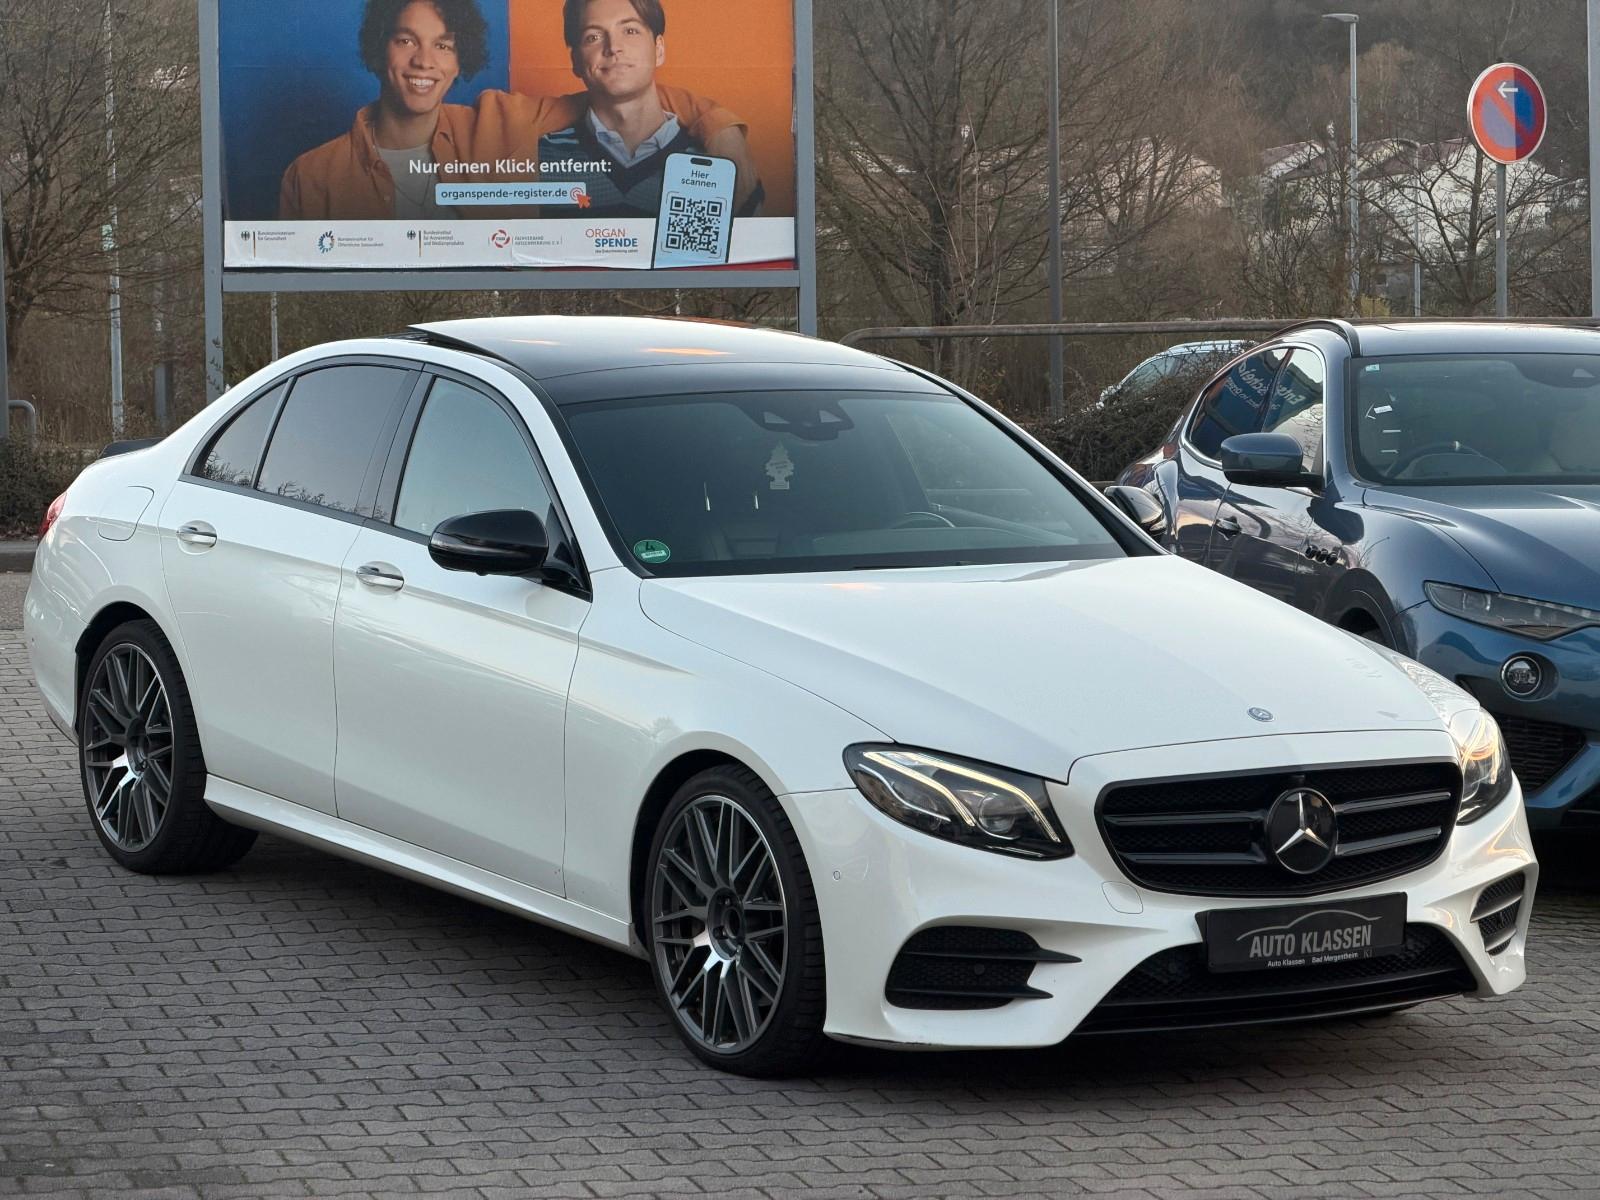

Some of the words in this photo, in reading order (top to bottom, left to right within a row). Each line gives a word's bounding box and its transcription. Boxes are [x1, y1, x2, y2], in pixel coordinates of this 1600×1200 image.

[409, 159, 440, 174] Nur
[444, 159, 490, 174] einen
[495, 158, 535, 173] Klick
[539, 158, 612, 173] entfernt:
[690, 169, 710, 180] Hier
[680, 177, 717, 189] scannen
[440, 188, 568, 200] organspende-register.de
[585, 228, 626, 238] ORGAN
[594, 237, 639, 248] SPENDE
[645, 541, 655, 551] 4
[1250, 933, 1296, 958] AUTO
[1301, 924, 1372, 954] KLASSEN
[1267, 960, 1282, 968] Auto
[1282, 958, 1306, 967] Klassen
[1311, 956, 1323, 964] Bad
[1323, 951, 1359, 963] Mergentheim
